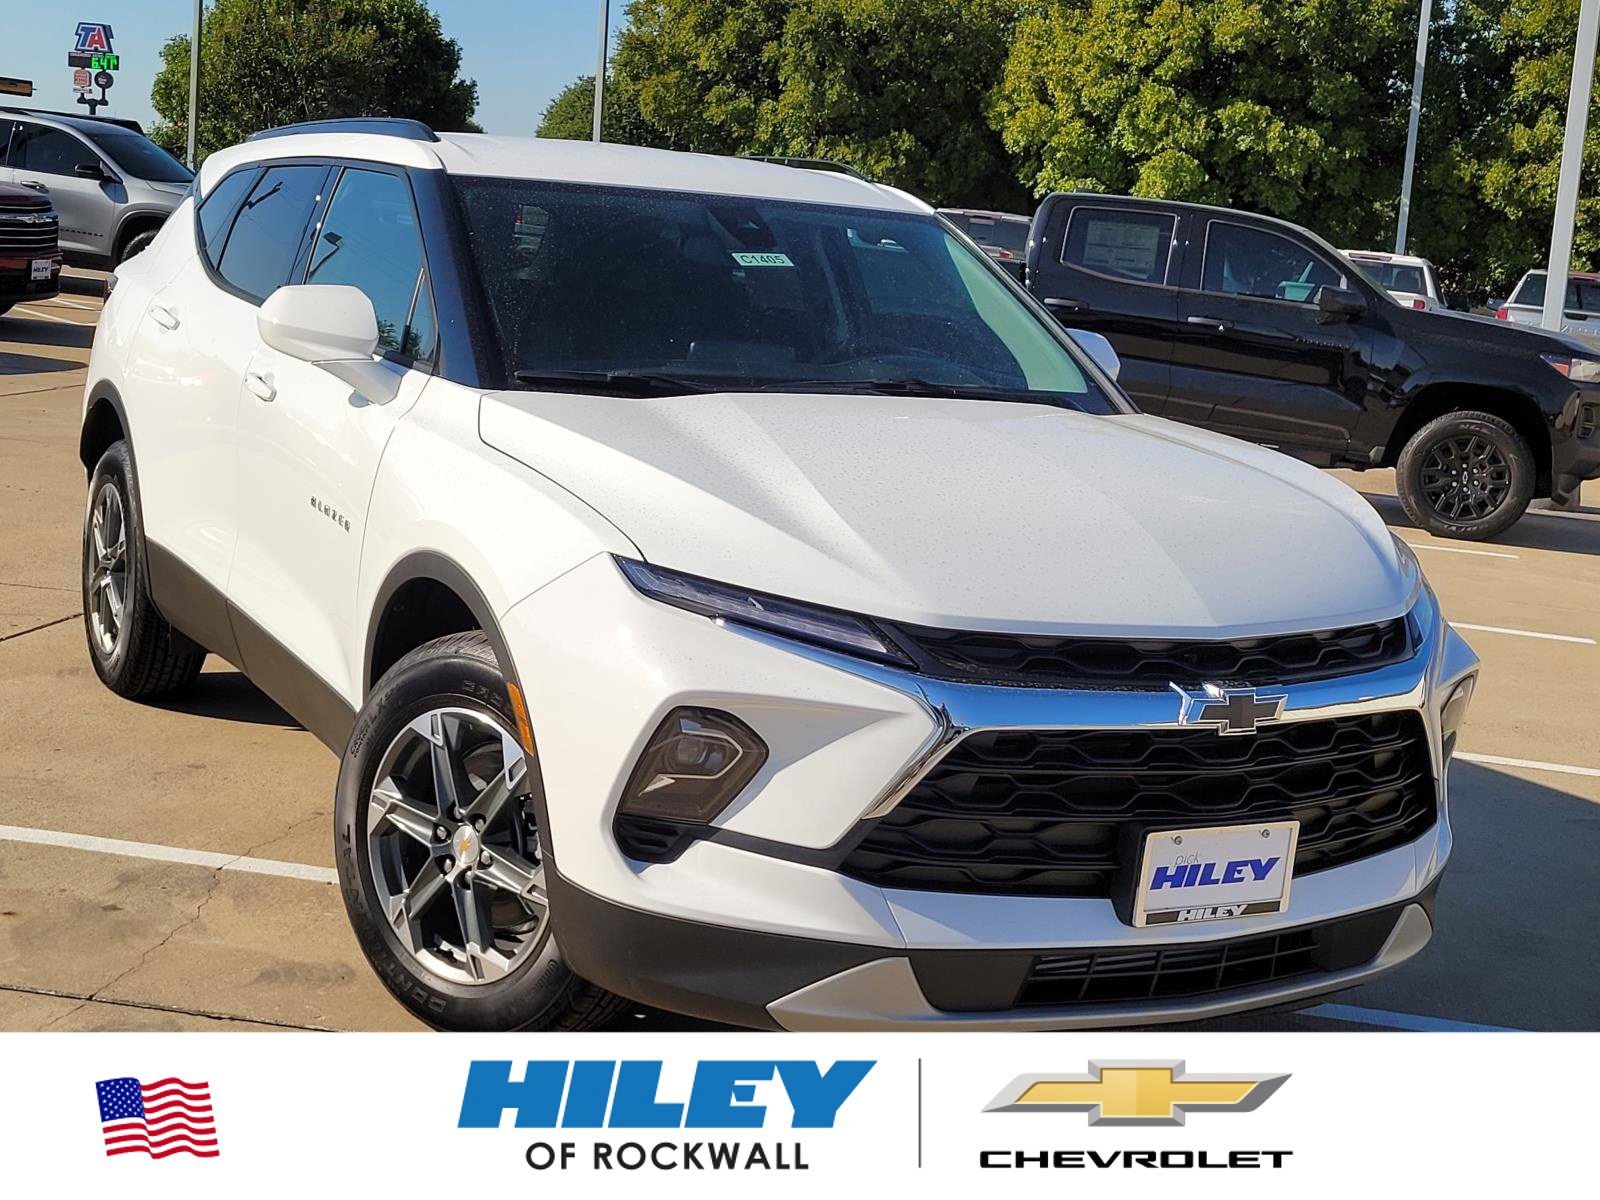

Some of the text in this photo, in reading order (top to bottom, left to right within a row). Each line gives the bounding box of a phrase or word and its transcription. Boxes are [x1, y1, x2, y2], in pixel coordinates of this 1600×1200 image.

[78, 25, 108, 50] TA
[740, 255, 785, 264] C1405
[310, 495, 351, 532] BLAZER
[1174, 850, 1199, 866] pick
[1150, 857, 1280, 890] HILEY
[1177, 904, 1249, 921] HILEY
